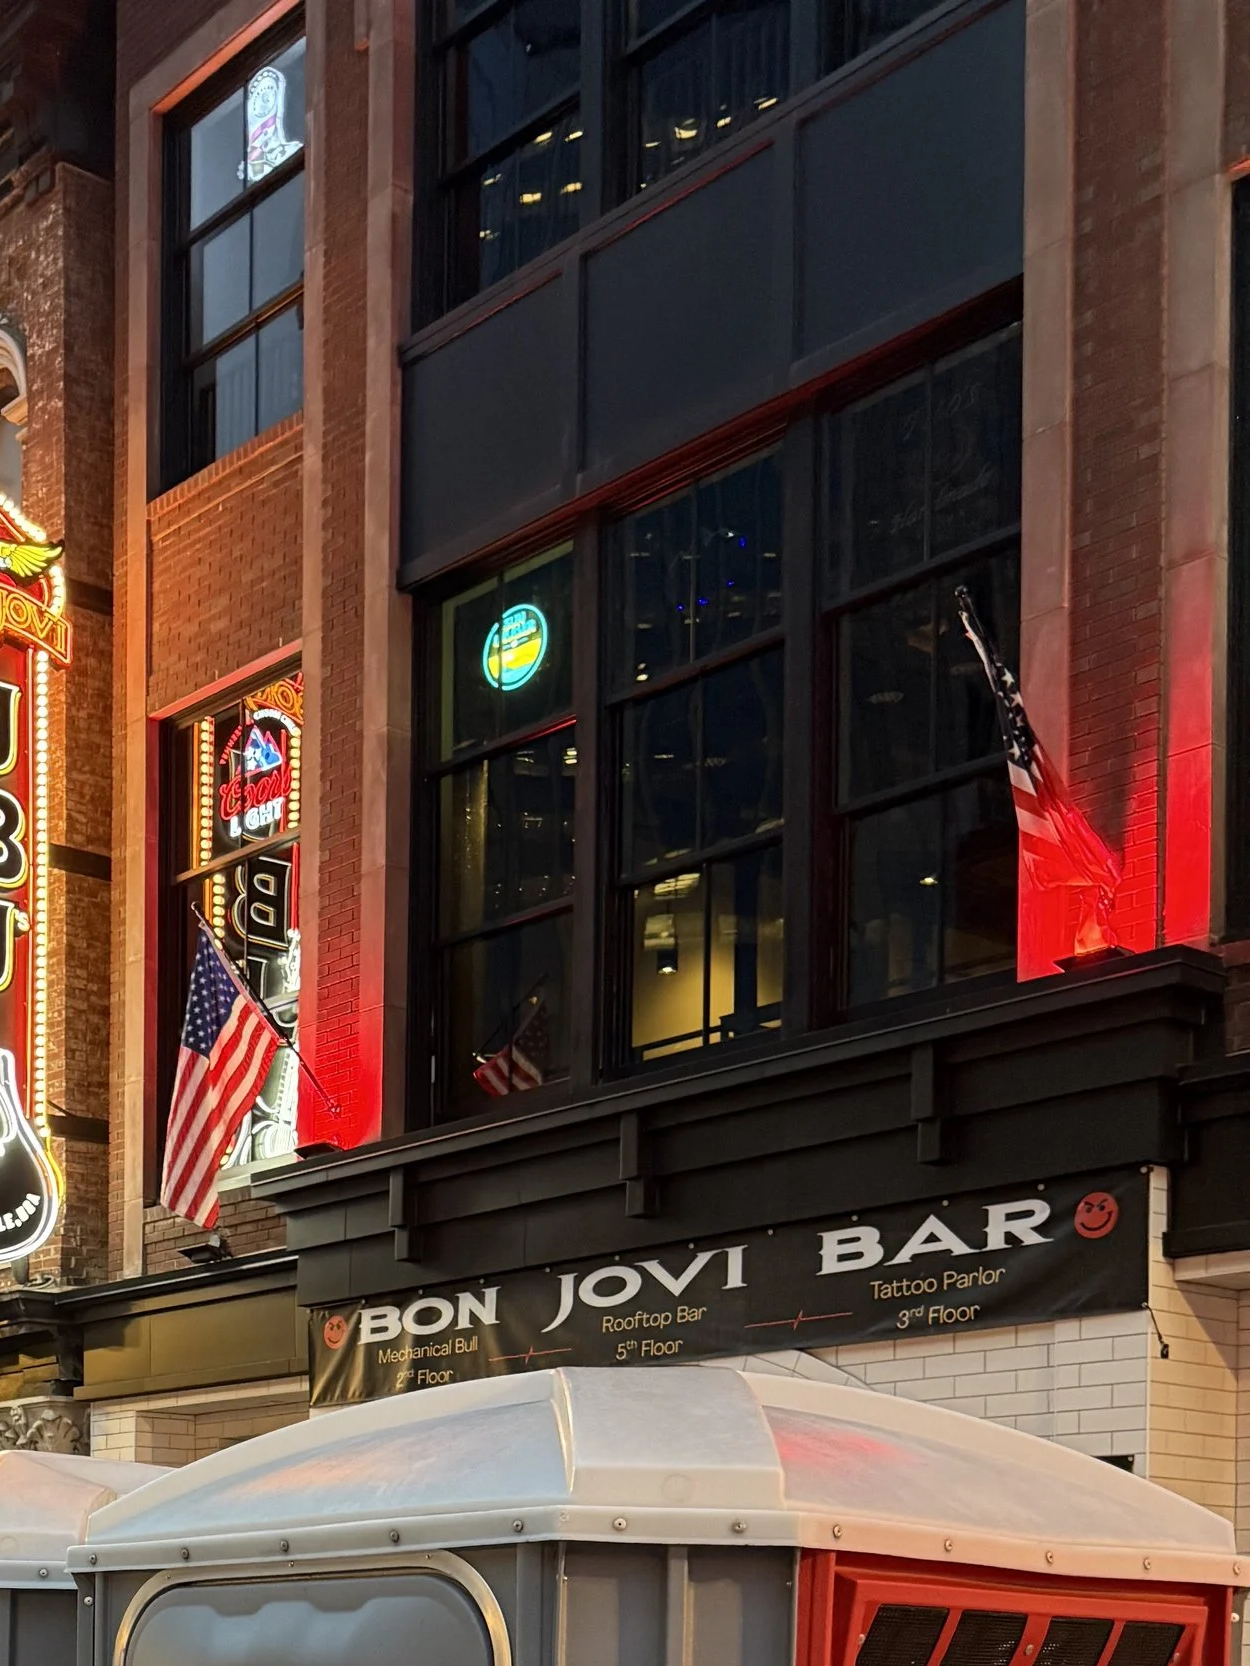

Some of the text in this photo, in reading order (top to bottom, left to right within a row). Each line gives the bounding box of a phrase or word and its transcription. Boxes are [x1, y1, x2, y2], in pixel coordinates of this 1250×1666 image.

[230, 797, 285, 838] LGHT
[358, 1199, 1054, 1346] BON JOVI BAR
[870, 1266, 1006, 1300] Tattoo Parlor
[602, 1305, 707, 1334] Rooftop Bar
[896, 1303, 980, 1330] 3rd Floor
[378, 1336, 478, 1364] Mechanical Bull
[615, 1337, 683, 1360] 5th Floor
[417, 1368, 454, 1385] Floor
